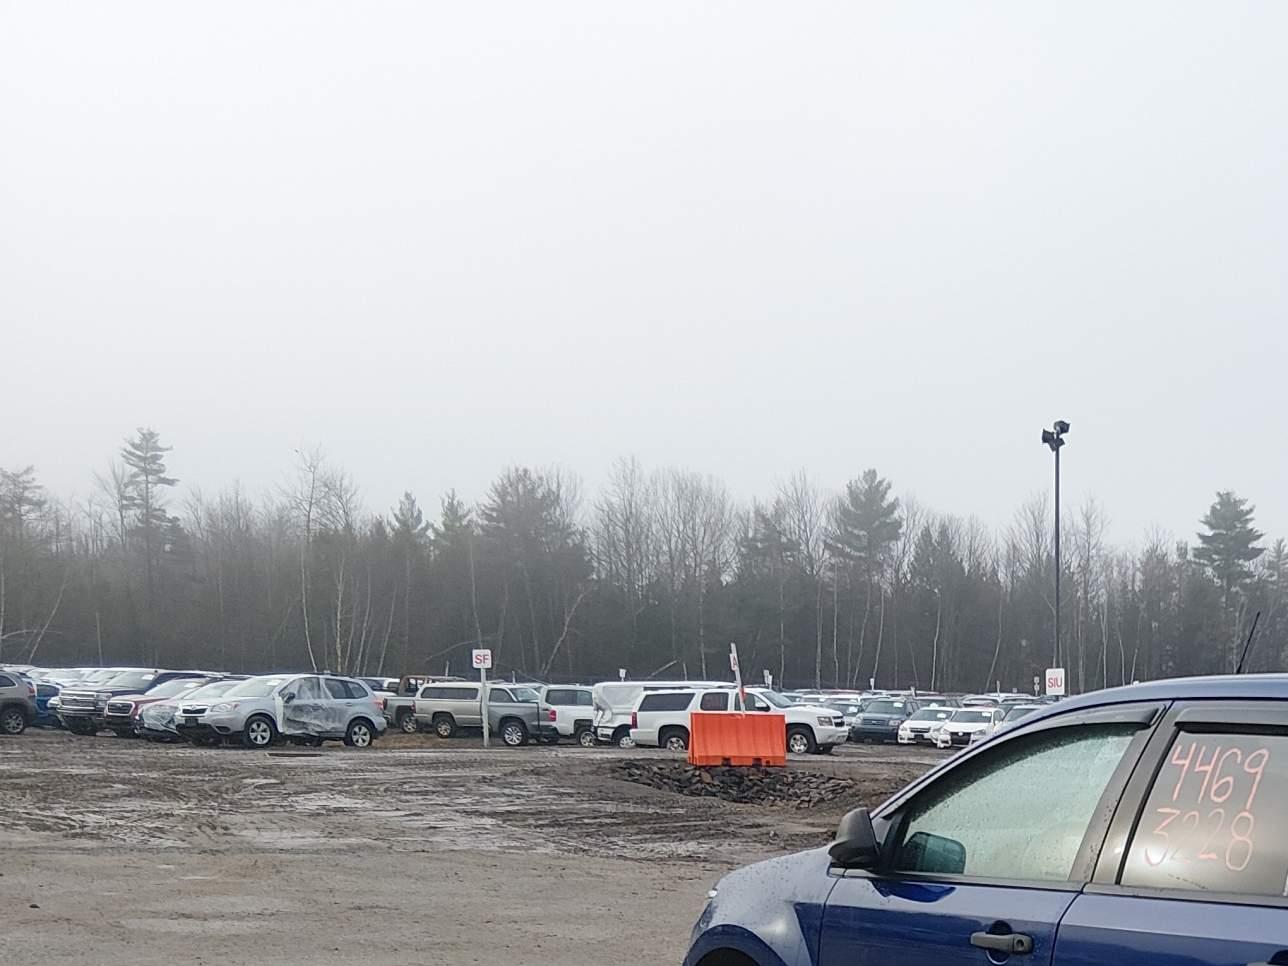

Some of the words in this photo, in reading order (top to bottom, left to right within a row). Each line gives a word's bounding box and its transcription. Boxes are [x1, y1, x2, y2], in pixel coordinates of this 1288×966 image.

[475, 654, 489, 665] SF
[1047, 677, 1063, 688] SIU
[1171, 742, 1269, 809] 4469
[1144, 807, 1255, 871] 3228
